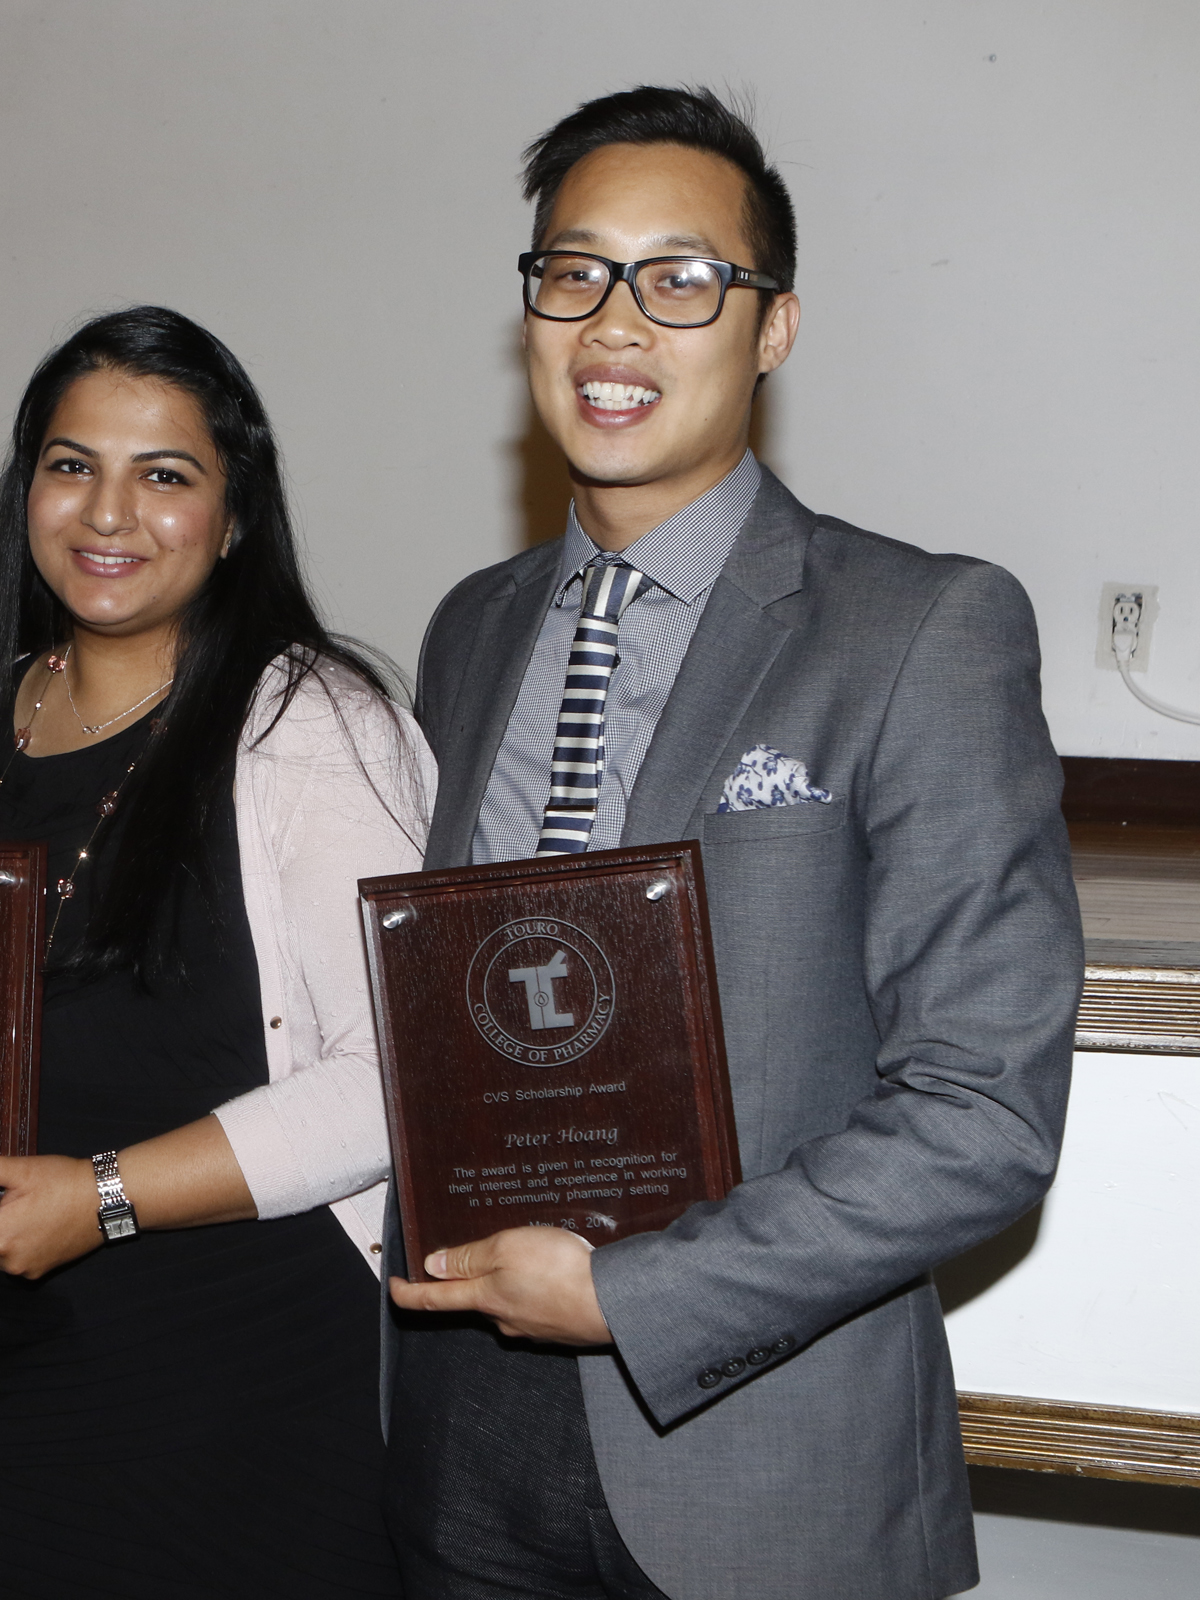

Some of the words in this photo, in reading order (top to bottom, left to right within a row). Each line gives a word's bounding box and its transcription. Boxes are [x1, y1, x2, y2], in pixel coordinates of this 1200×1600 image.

[504, 922, 558, 940] TOURO
[474, 1003, 524, 1057] COLLEGE
[529, 1050, 548, 1061] OF
[554, 993, 610, 1060] PHARMACY
[483, 1092, 509, 1104] CVS
[516, 1086, 582, 1100] Scholarship
[589, 1081, 626, 1094] Award
[504, 1133, 551, 1148] Peter
[557, 1126, 618, 1144] Hoang
[453, 1168, 475, 1178] The
[482, 1164, 516, 1176] award
[522, 1163, 531, 1173] is
[538, 1161, 568, 1174] given
[574, 1159, 584, 1169] in
[591, 1153, 655, 1168] recognition
[661, 1151, 677, 1162] for
[449, 1183, 473, 1194] their
[479, 1179, 521, 1191] interest
[527, 1177, 548, 1188] and
[555, 1173, 618, 1188] experience
[624, 1170, 634, 1180] in
[641, 1165, 687, 1178] working
[469, 1197, 479, 1207] in
[486, 1198, 492, 1206] a
[499, 1191, 560, 1205] community
[567, 1187, 623, 1202] pharmacy
[630, 1182, 669, 1195] setting
